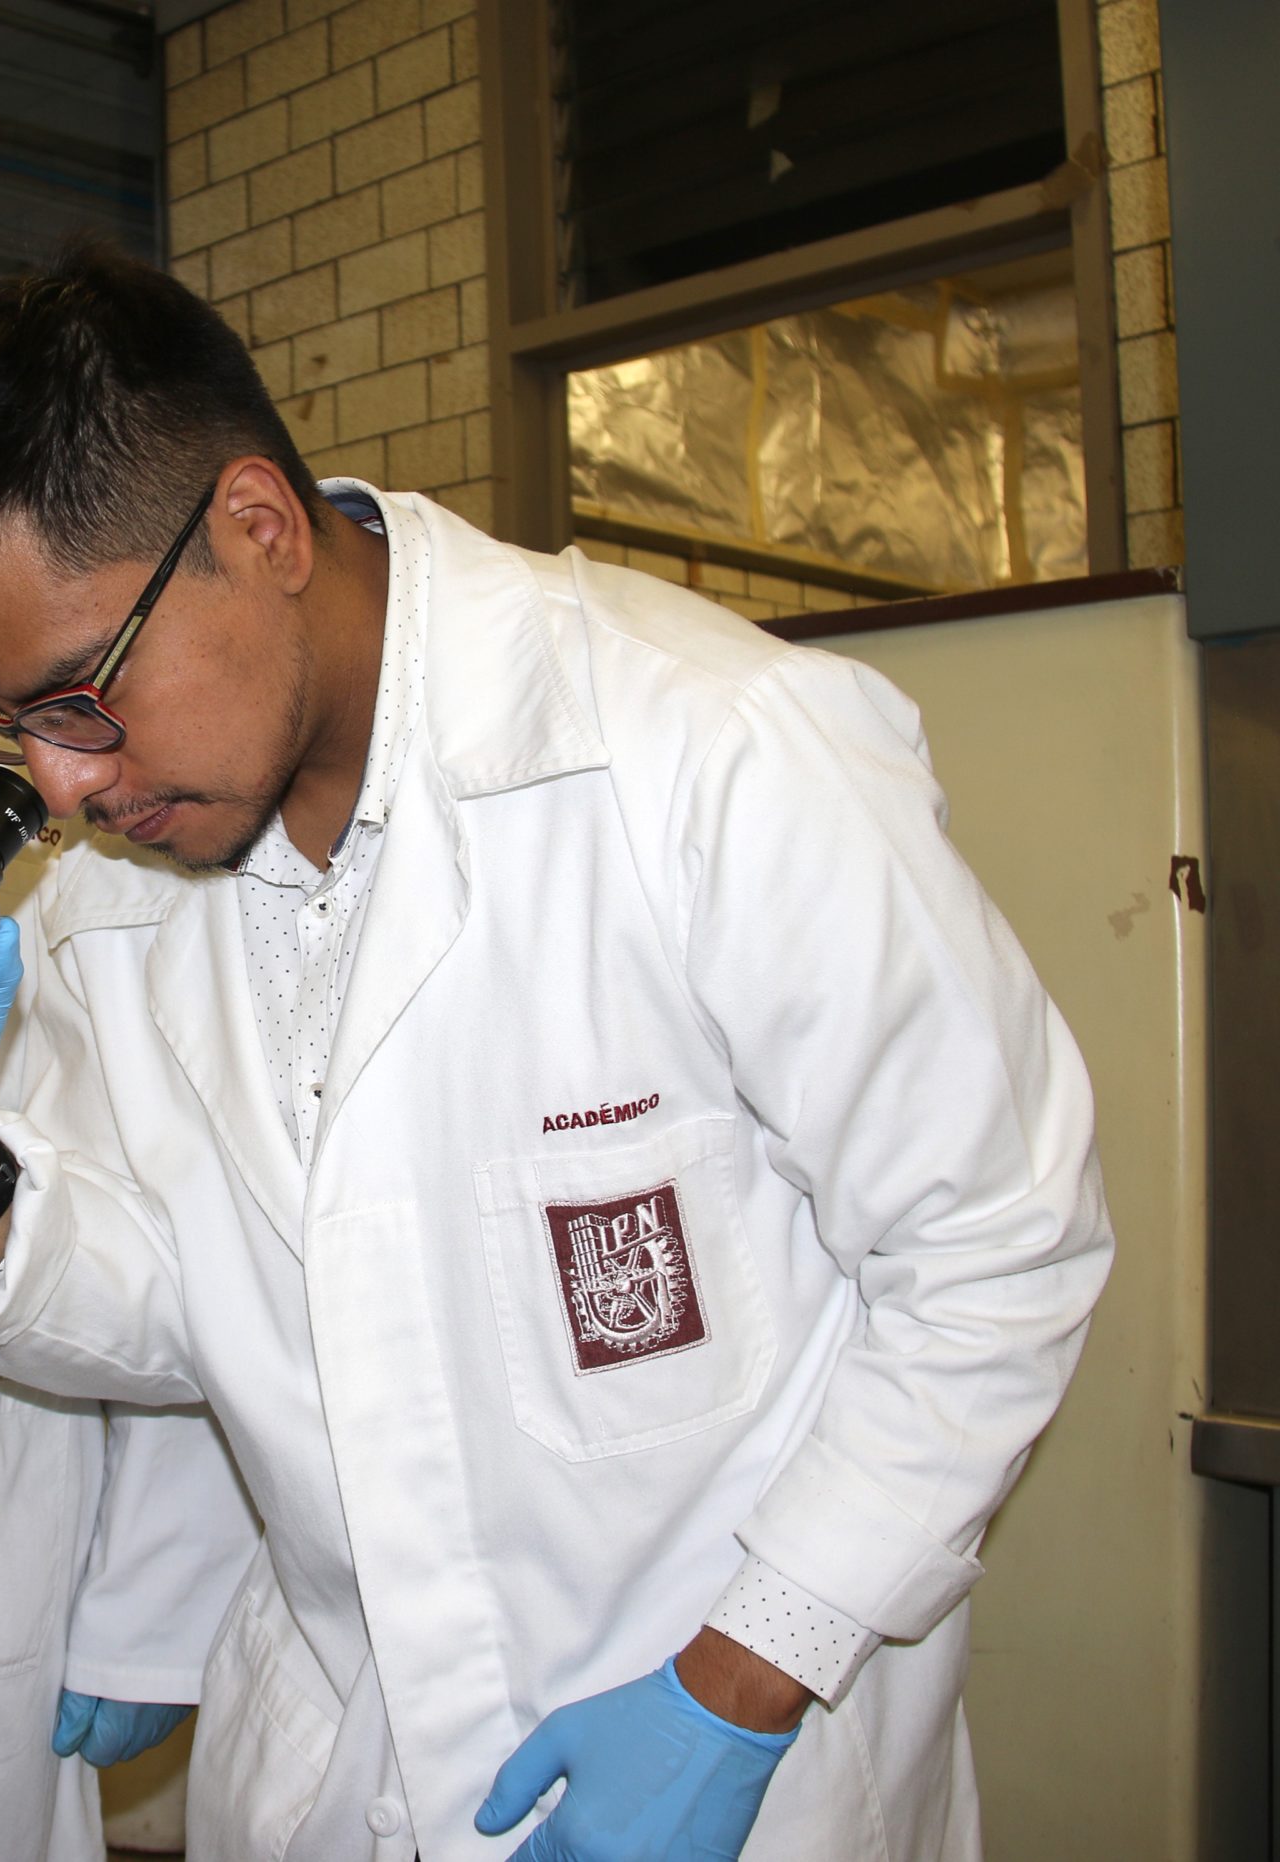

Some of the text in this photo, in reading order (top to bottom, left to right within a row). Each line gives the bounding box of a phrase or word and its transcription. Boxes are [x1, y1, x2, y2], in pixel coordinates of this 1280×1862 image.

[5, 807, 21, 822] WF
[542, 1093, 660, 1135] ACADÉMICO
[596, 1195, 670, 1258] IPN
